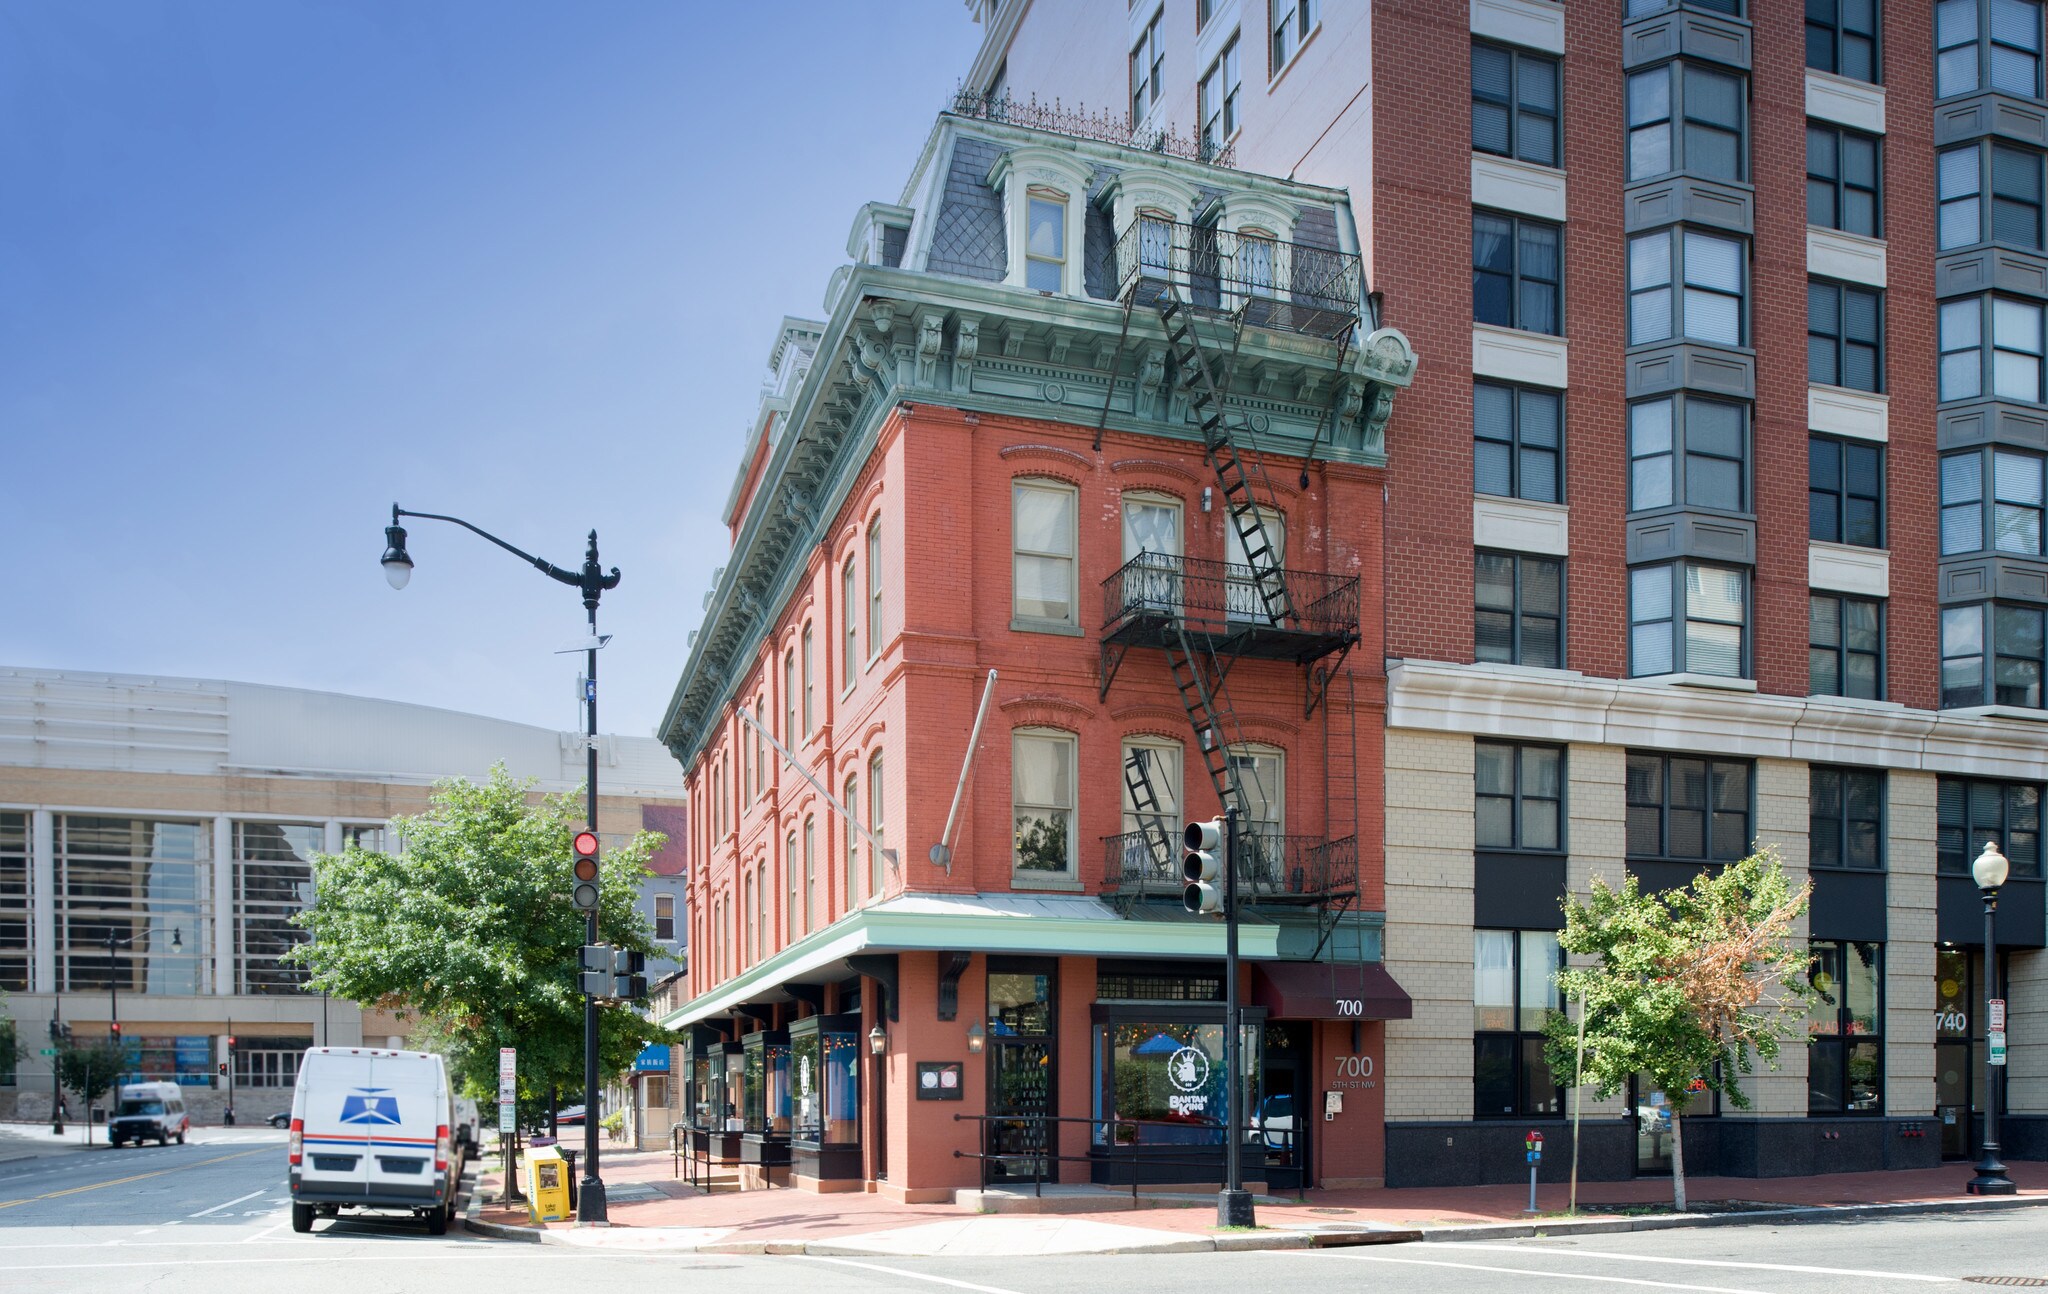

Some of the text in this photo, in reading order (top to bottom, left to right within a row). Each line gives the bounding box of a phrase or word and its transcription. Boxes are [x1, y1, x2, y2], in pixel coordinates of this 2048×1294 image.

[1336, 999, 1363, 1016] 700
[1935, 1012, 1967, 1031] 740
[1334, 1056, 1373, 1077] 700
[1332, 1081, 1376, 1089] 5TH ST NW
[1169, 1095, 1208, 1109] BANTAM
[1179, 1103, 1204, 1116] KING
